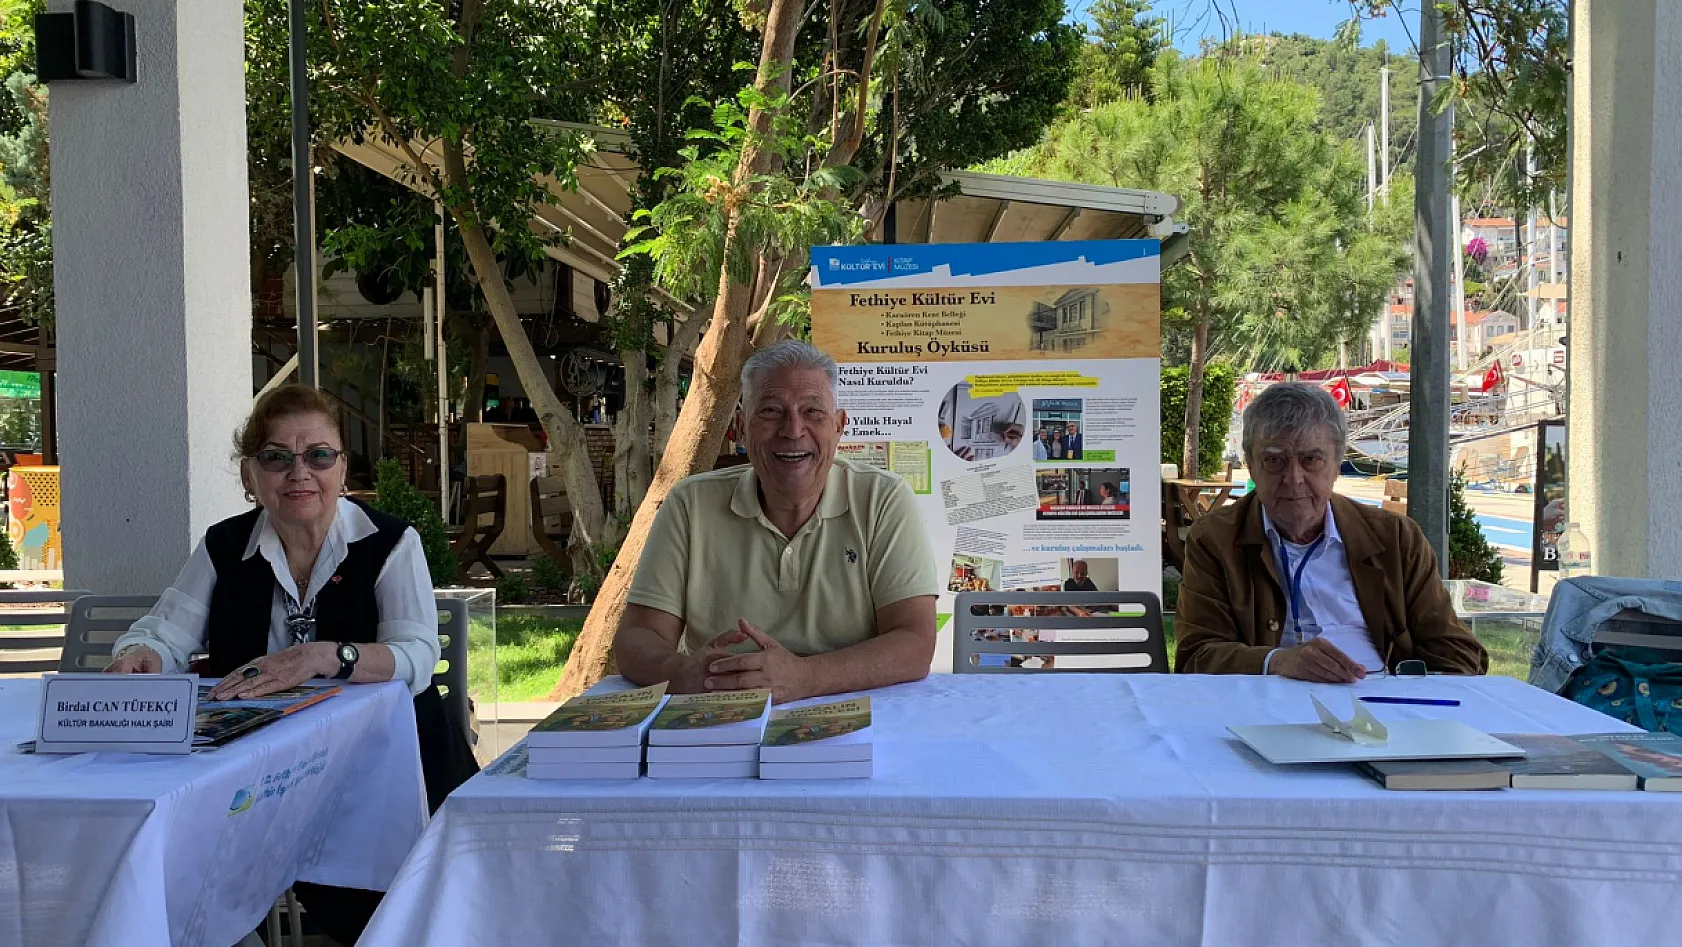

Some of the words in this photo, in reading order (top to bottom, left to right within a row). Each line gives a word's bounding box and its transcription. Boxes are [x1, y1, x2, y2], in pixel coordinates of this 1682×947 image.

[849, 293, 907, 309] Fethiye
[911, 292, 966, 306] Kültür
[969, 291, 996, 305] Evi
[885, 329, 912, 337] Fethiye
[913, 329, 934, 337] Kitap
[935, 328, 962, 336] Müzesi
[857, 341, 922, 357] Kuruluş
[927, 337, 990, 357] Öyküsü
[838, 366, 874, 377] Fethiye
[876, 366, 910, 375] Kültür
[912, 365, 928, 375] Evi
[838, 377, 864, 386] Nasıl
[866, 377, 914, 386] Kuruldu?
[852, 416, 881, 426] Yıllık
[882, 416, 913, 427] Hayal
[1041, 544, 1070, 553] kuruluş
[1071, 543, 1114, 553] çalışmaları
[57, 701, 90, 712] Birdal
[92, 700, 120, 712] CAN
[122, 698, 178, 714] TÜFEKÇİ
[57, 718, 87, 727] KÜLTÜR
[88, 718, 130, 728] BAKANLIĞI
[131, 719, 152, 727] HALK
[153, 718, 174, 729] ŞAİRİ
